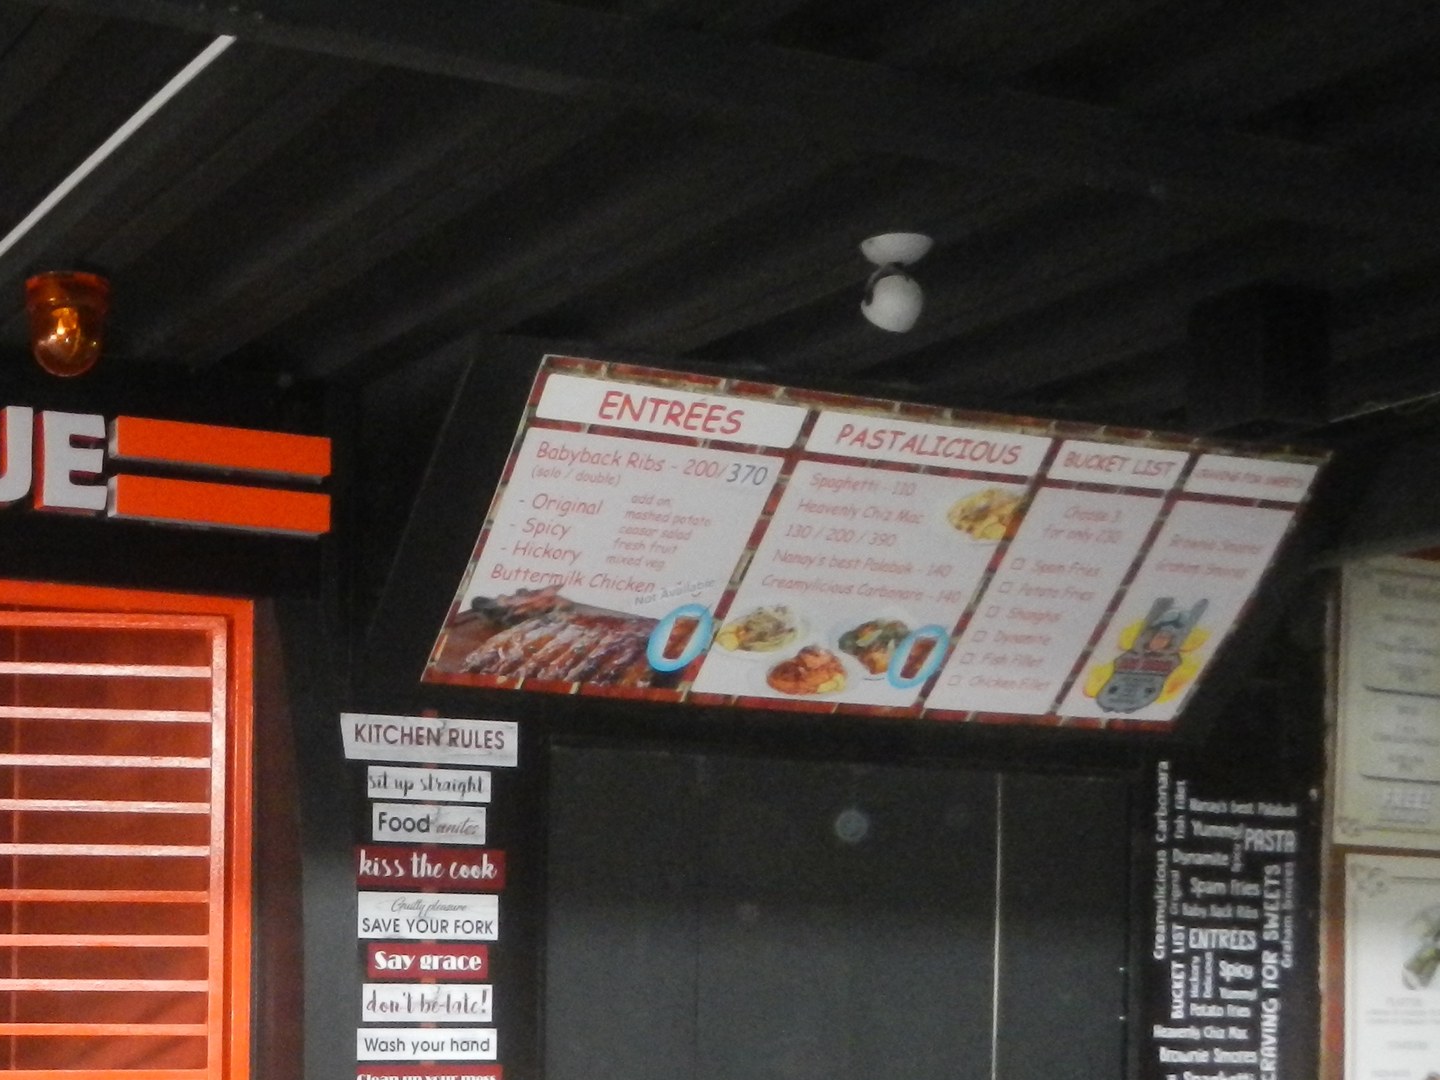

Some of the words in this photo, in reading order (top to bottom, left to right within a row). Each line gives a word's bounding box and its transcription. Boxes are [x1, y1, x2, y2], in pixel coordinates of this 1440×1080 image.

[535, 440, 621, 468] Babyback
[627, 452, 665, 472] Ribs
[835, 423, 1022, 465] PASTALICIOUS
[1063, 451, 1131, 473] BUCKET
[1132, 458, 1177, 476] LIST
[532, 493, 604, 516] Original
[522, 517, 571, 539] Spicy
[512, 540, 581, 565] Hickory
[490, 563, 582, 586] Buttermilk
[588, 573, 656, 593] Chicken
[355, 723, 440, 747] KITCHEN
[447, 728, 505, 750] RULES
[369, 771, 388, 788] sit
[395, 779, 414, 797] up
[420, 773, 484, 800] straight
[378, 811, 431, 833] Food
[1244, 829, 1297, 852] PASTA
[359, 849, 405, 877] kiss
[410, 851, 445, 878] the
[449, 852, 497, 879] cook
[362, 918, 400, 933] SAVE
[406, 919, 448, 934] YOUR
[454, 920, 494, 935] FORK
[374, 951, 415, 970] Say
[420, 953, 483, 971] grace
[1261, 950, 1280, 989] FOR
[366, 990, 412, 1014] don't
[364, 1037, 405, 1052] Wash
[411, 1040, 445, 1055] your
[450, 1037, 490, 1052] hand
